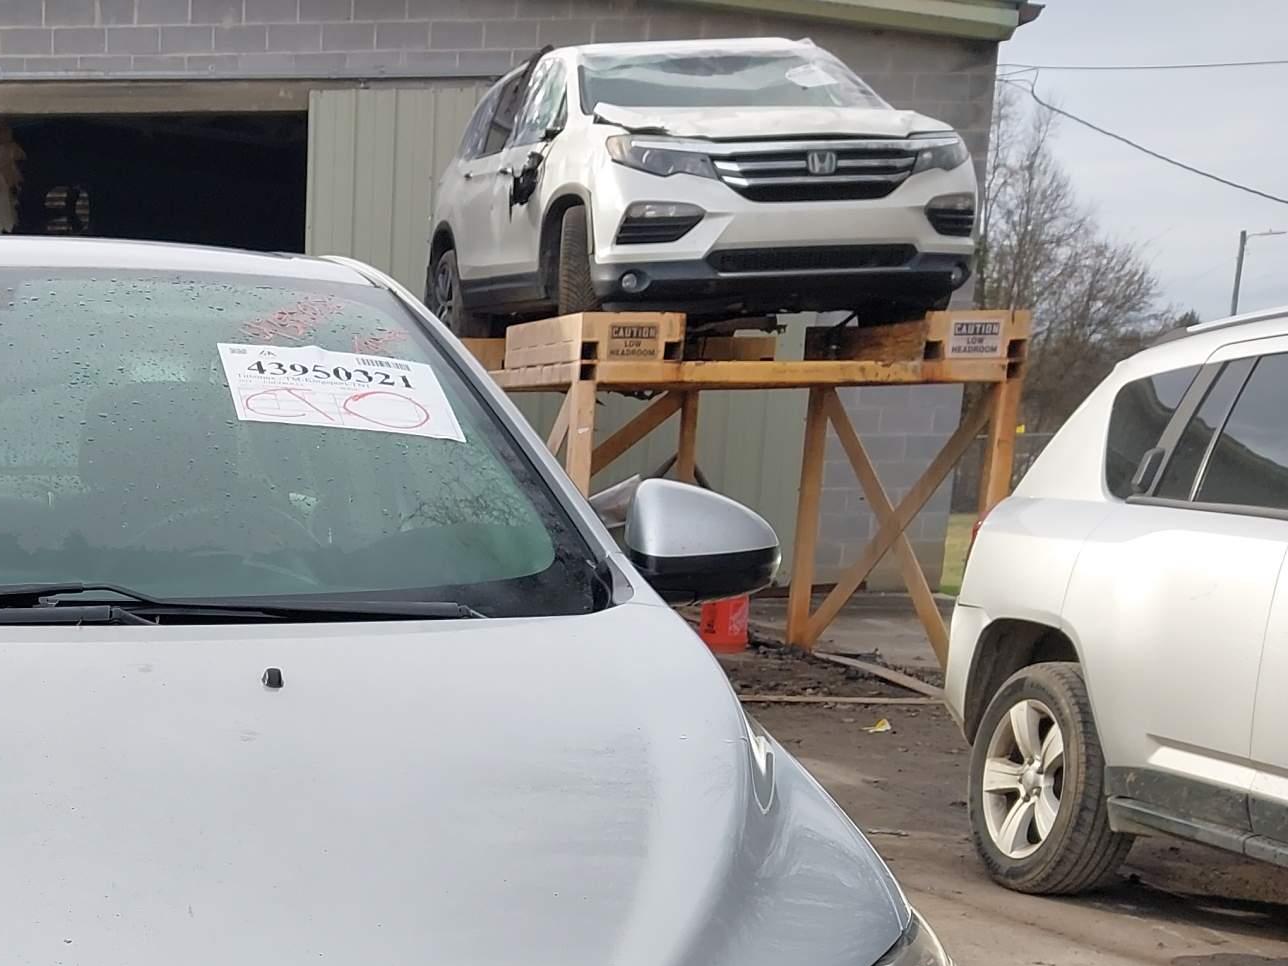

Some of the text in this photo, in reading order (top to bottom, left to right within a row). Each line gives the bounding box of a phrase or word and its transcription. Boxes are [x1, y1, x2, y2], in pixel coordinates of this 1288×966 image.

[612, 326, 656, 338] CAUTION
[955, 323, 999, 335] CAUTION
[624, 340, 641, 348] LOW
[967, 336, 985, 344] LOW
[610, 348, 656, 356] HEADROOM
[952, 345, 998, 353] HEADROOM
[247, 360, 414, 388] 43950321
